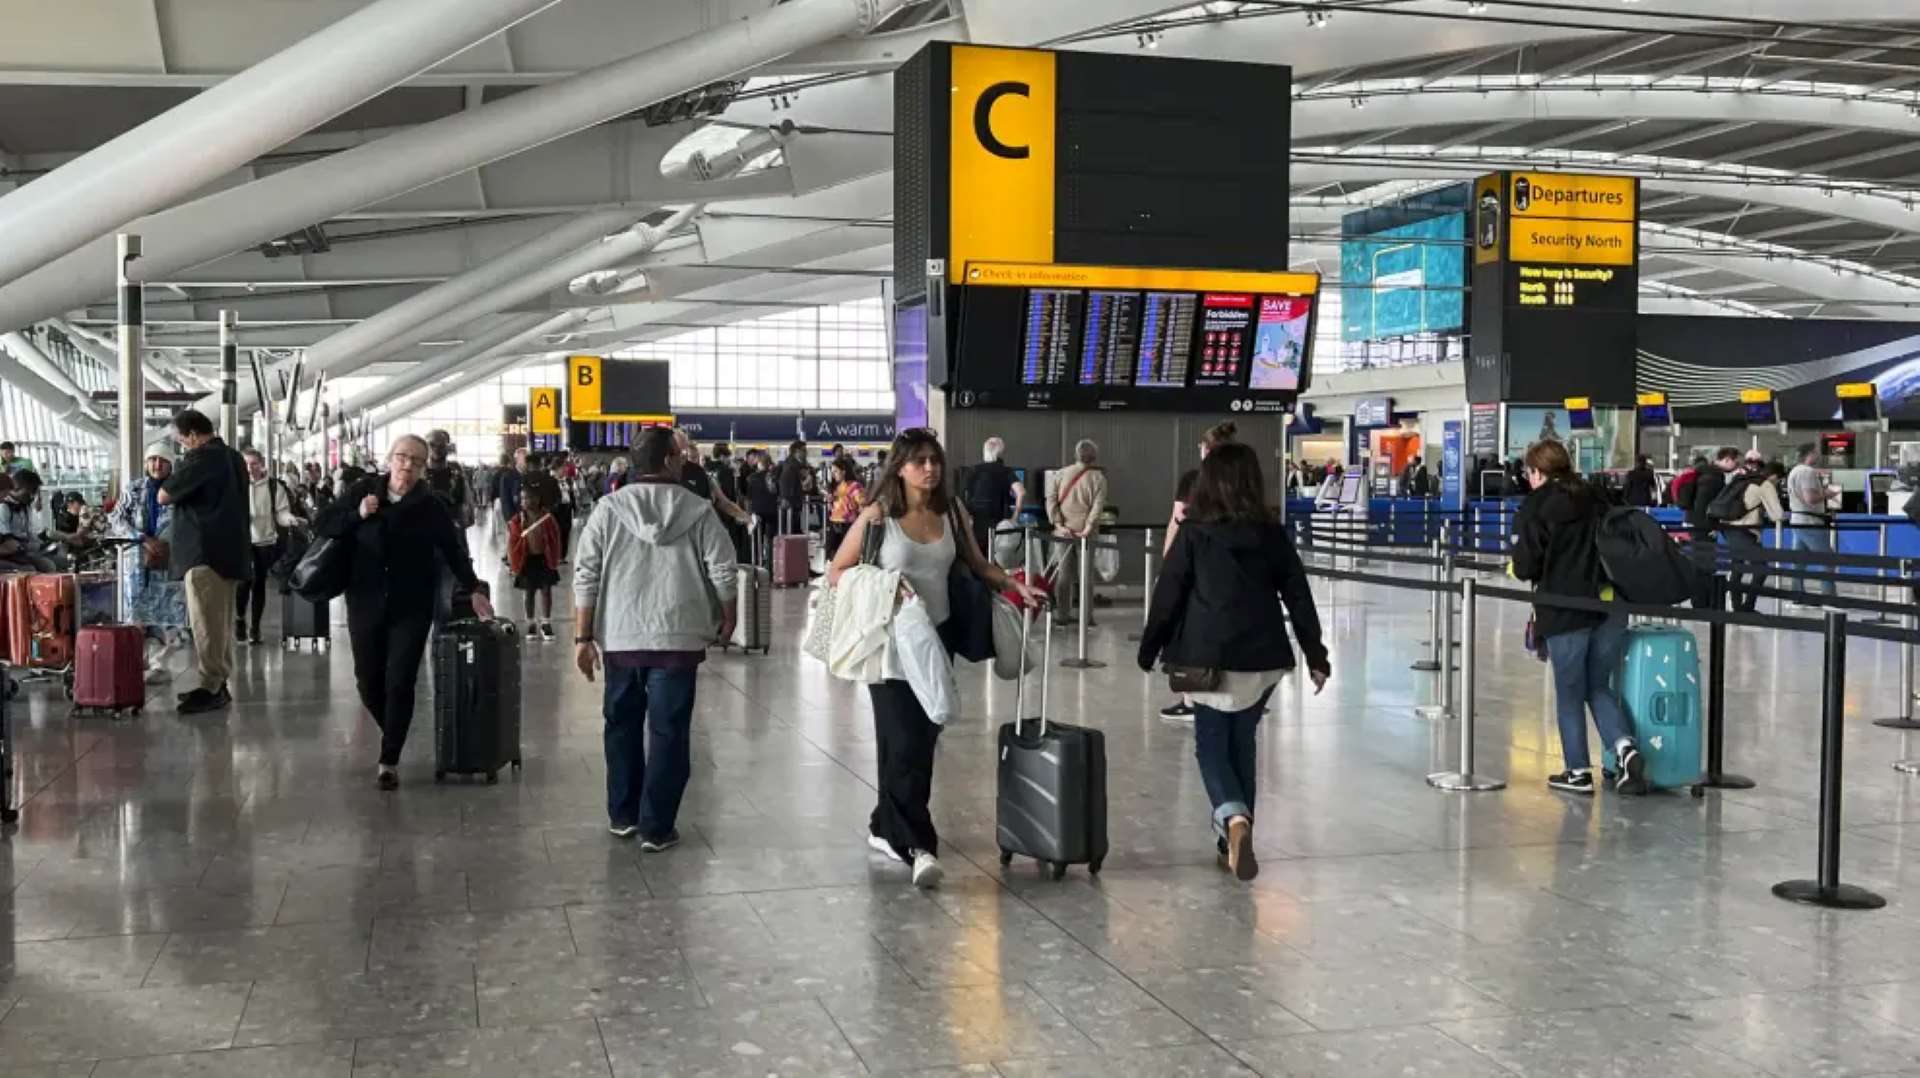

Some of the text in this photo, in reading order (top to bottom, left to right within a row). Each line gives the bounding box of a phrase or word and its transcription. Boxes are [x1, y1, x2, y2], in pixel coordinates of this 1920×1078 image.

[973, 80, 1030, 160] C
[1532, 184, 1624, 205] Departures
[1531, 231, 1622, 250] Security North
[982, 269, 1088, 281] Check-in information
[1520, 267, 1541, 278] How
[1564, 267, 1574, 279] is
[1520, 282, 1546, 293] North
[1263, 299, 1292, 311] SAVE
[1520, 294, 1546, 305] South
[1206, 309, 1249, 319] Forbidden
[577, 365, 594, 386] B
[536, 393, 551, 408] A
[817, 420, 832, 436] A
[835, 423, 880, 436] warm
